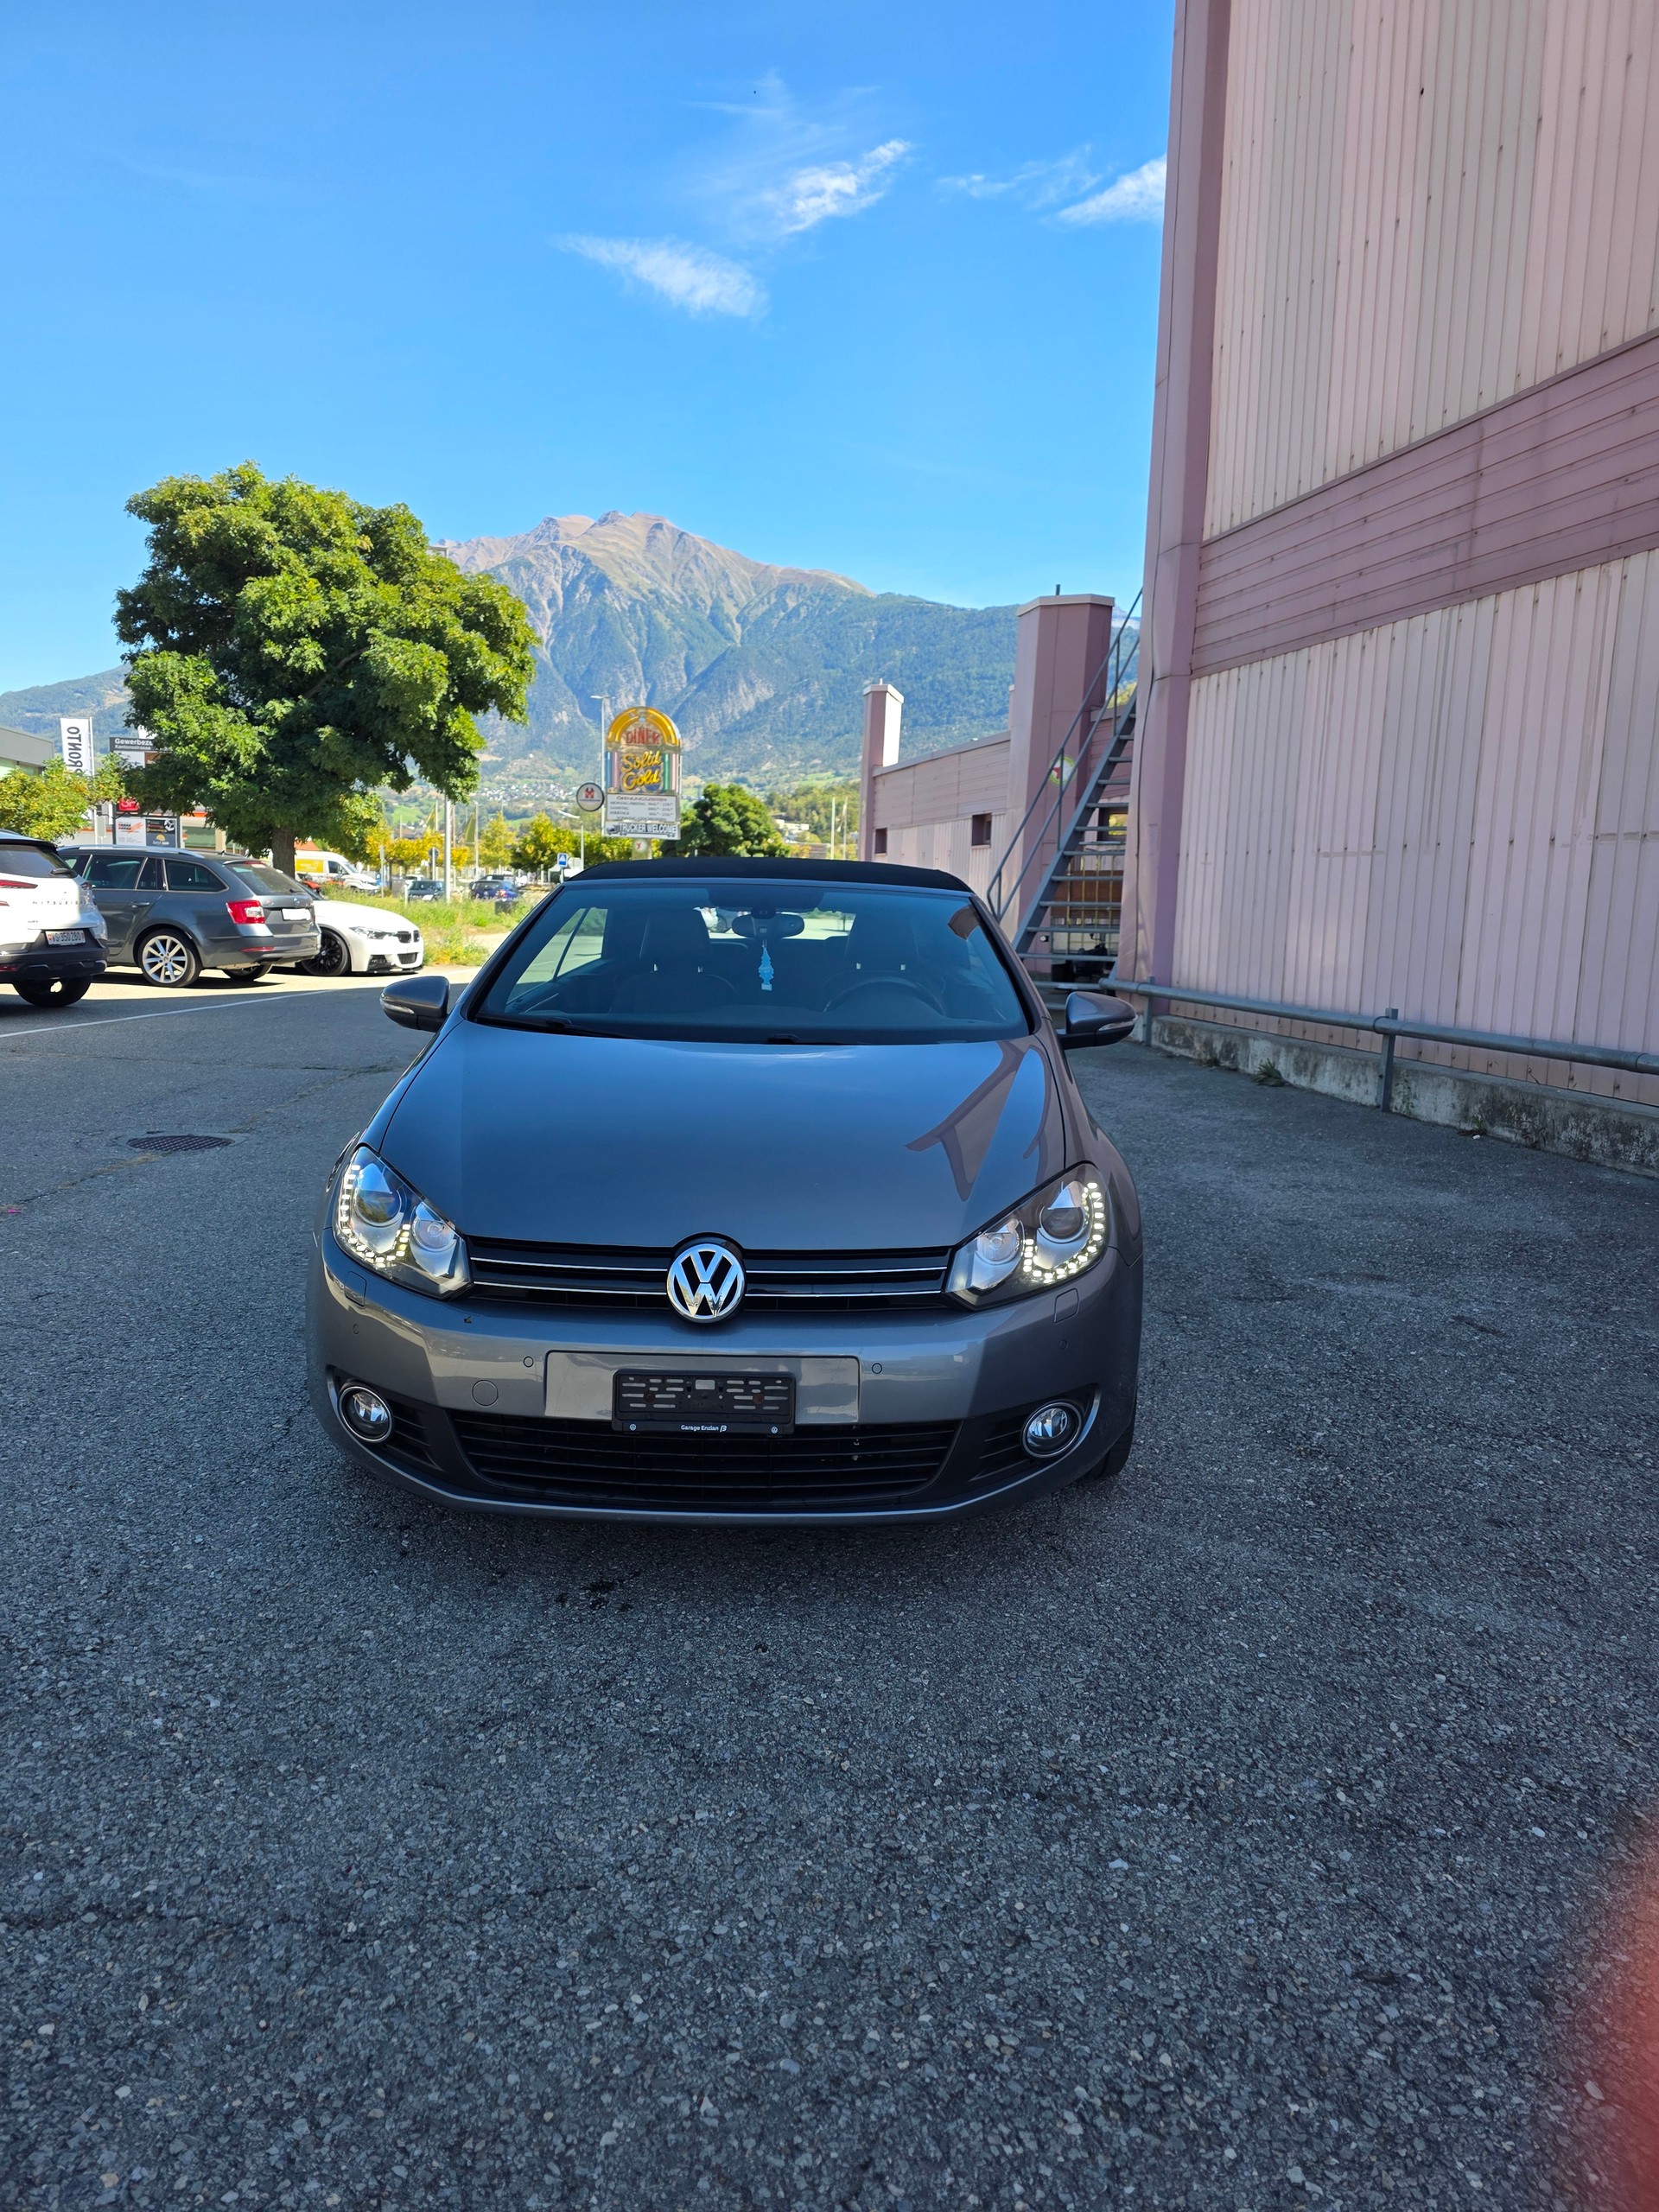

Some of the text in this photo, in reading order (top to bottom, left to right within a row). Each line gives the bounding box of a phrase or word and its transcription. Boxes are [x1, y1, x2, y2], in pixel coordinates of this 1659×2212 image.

[626, 726, 659, 744] DINER
[621, 751, 662, 772] Solid
[623, 769, 660, 790] Gold
